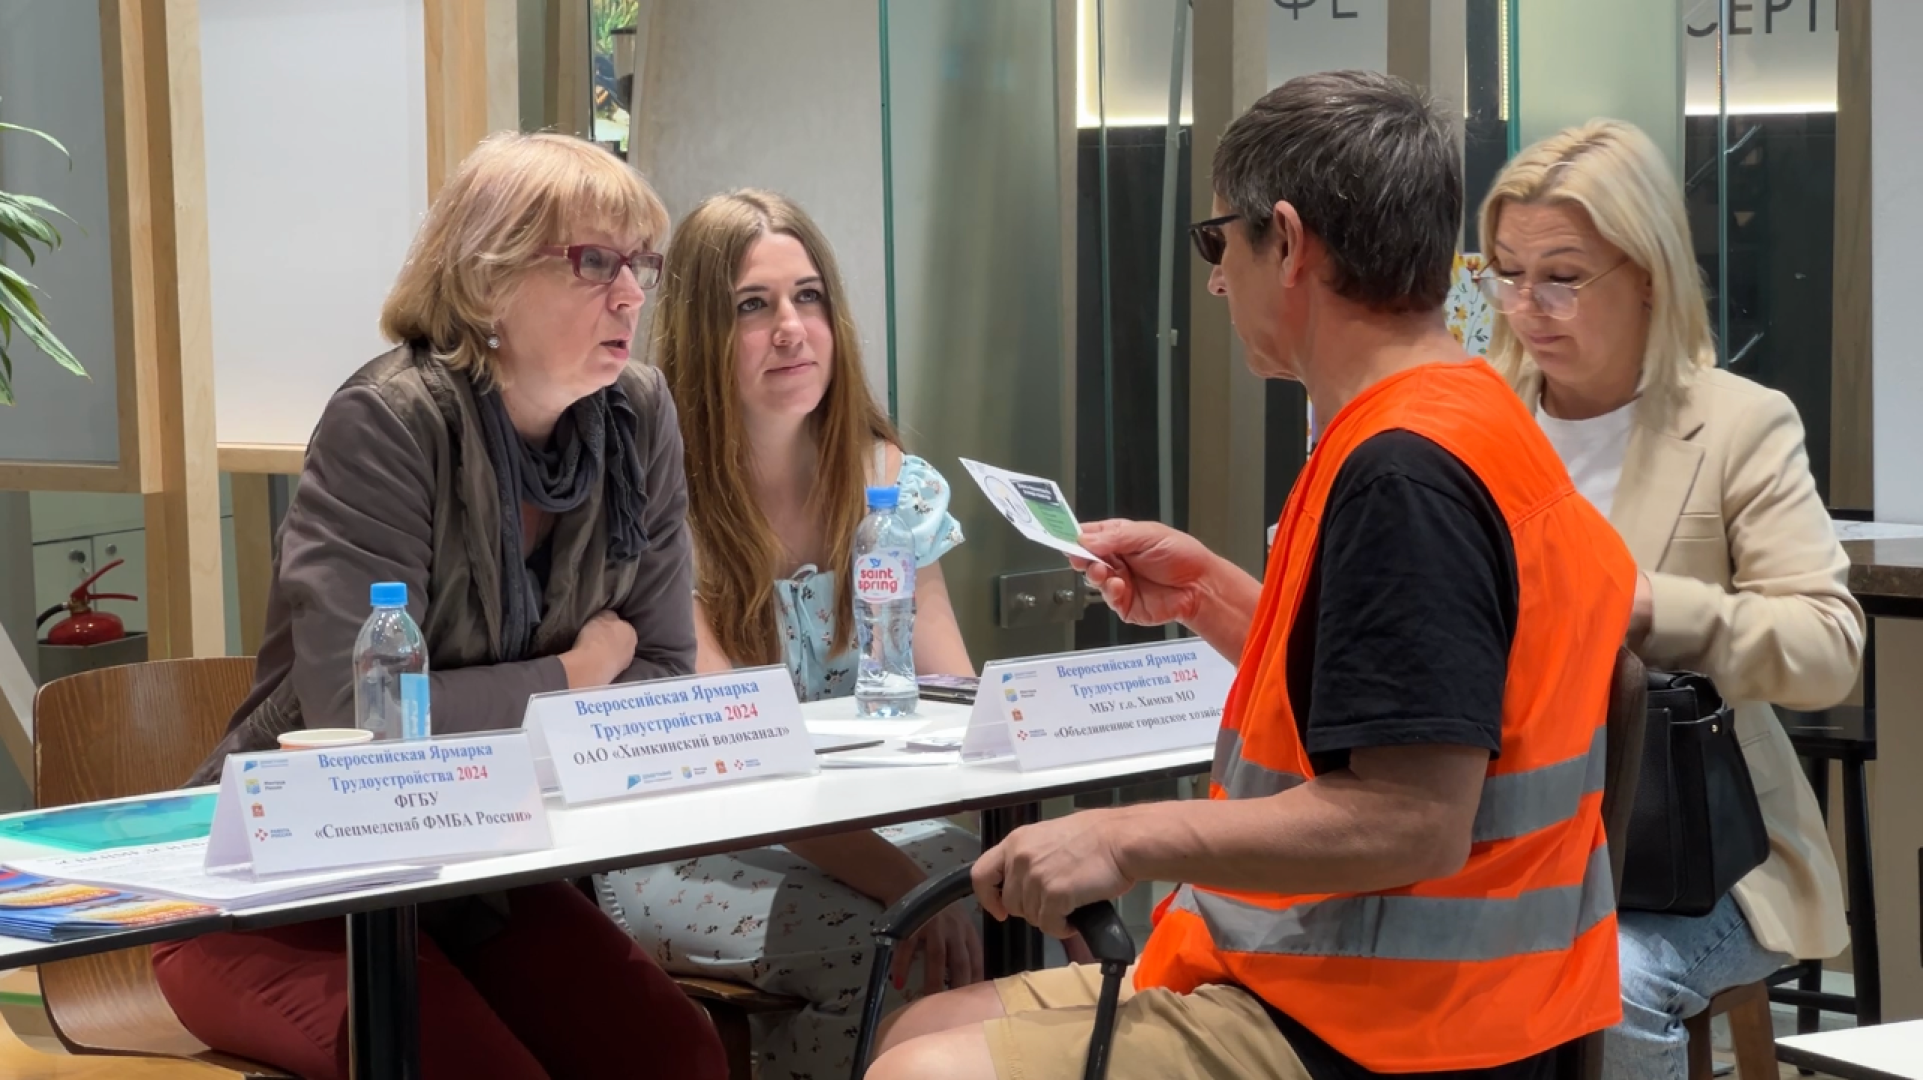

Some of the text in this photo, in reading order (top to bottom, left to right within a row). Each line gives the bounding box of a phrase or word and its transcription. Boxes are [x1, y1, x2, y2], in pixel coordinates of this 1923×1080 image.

[858, 580, 897, 593] spring
[861, 568, 893, 579] saint
[1057, 658, 1143, 678] Всероссийская
[1146, 651, 1197, 666] Ярмарка
[1071, 669, 1198, 697] Трудоустройства 2024
[575, 681, 759, 716] Всероссийская Ярмарка
[1089, 700, 1115, 714] МБУ
[1138, 693, 1175, 709] Химки
[1176, 689, 1195, 703] МО
[591, 703, 759, 741] Трудоустройства 2024
[1053, 720, 1134, 738] «Объединенное
[1136, 711, 1187, 728] городское
[318, 744, 493, 770] Всероссийская Ярмарка
[573, 726, 789, 765] ОАО «Химкинский водоканал»
[328, 765, 488, 793] Трудоустройства 2024
[394, 792, 439, 807] ФГБУ
[315, 809, 533, 839] «Спецмедснаб ФМБА России»
